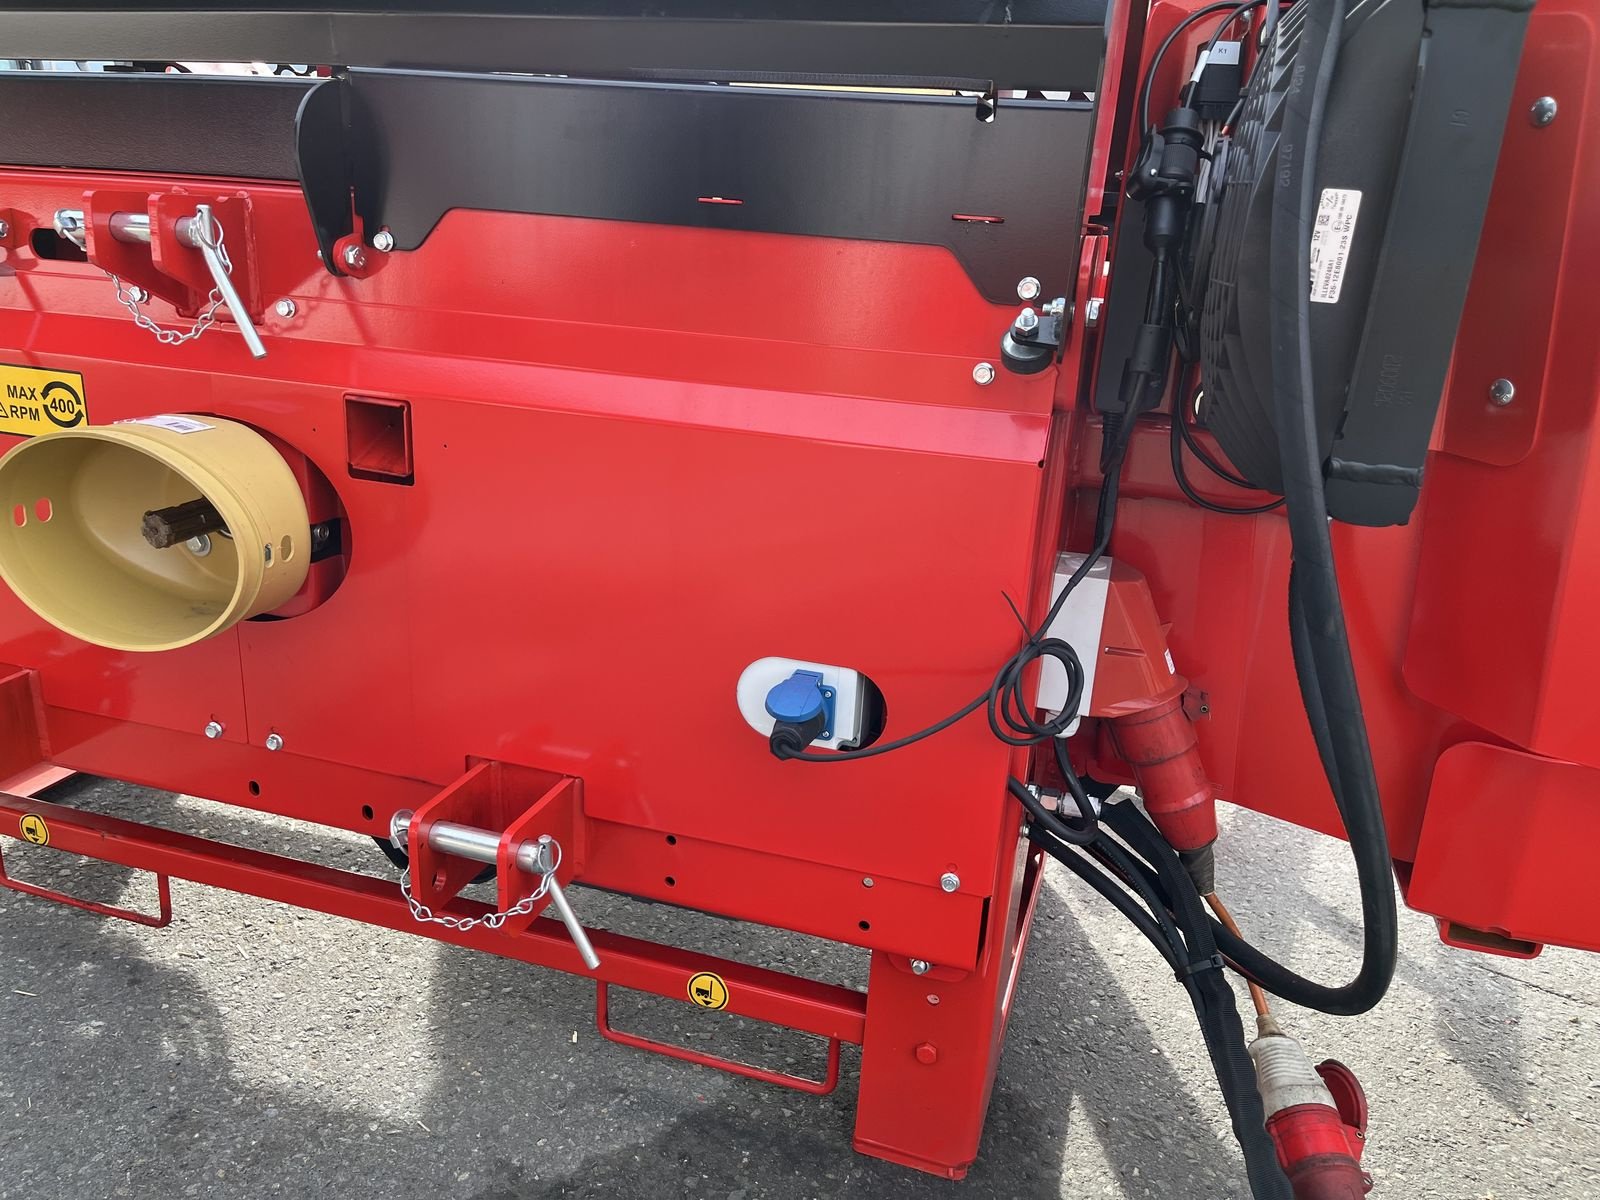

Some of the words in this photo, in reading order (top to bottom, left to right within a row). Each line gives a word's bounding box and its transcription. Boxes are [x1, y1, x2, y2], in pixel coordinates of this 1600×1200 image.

[1343, 215, 1353, 232] WPC
[1313, 231, 1321, 241] 12V
[7, 384, 38, 401] MAX
[9, 404, 41, 421] RPM
[50, 397, 75, 414] 400
